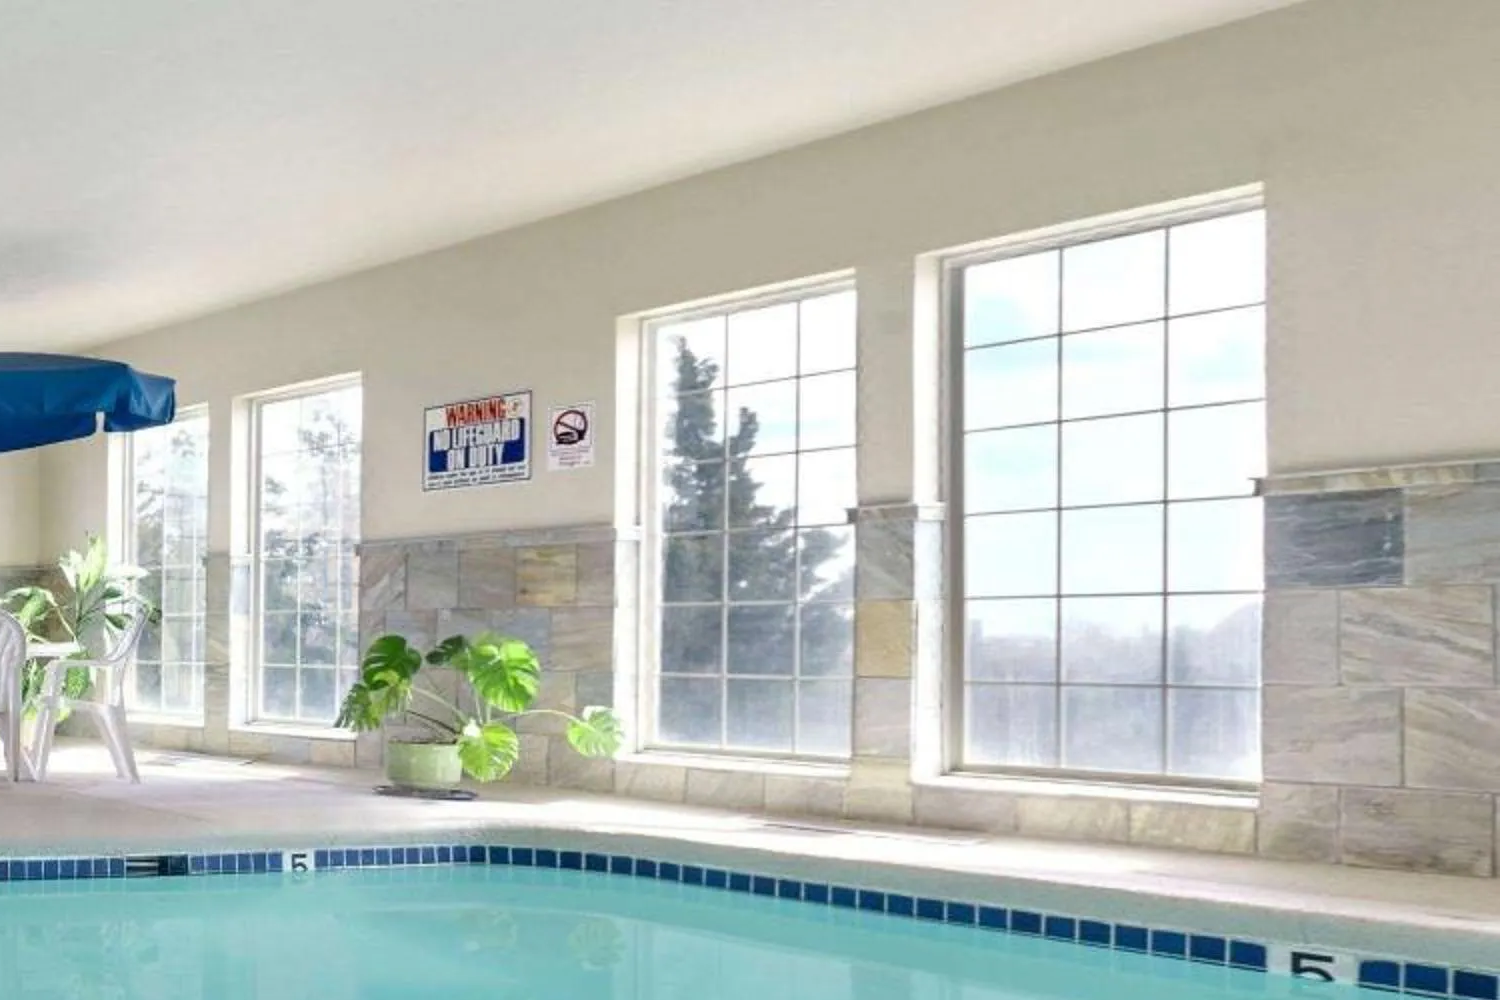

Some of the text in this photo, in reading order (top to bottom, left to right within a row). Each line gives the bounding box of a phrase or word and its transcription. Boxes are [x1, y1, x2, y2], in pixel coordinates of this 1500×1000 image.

[445, 396, 507, 427] WARNING
[433, 418, 521, 452] NO LIFEGUARD
[447, 442, 506, 471] ON DUTY
[291, 853, 308, 872] 5
[1291, 951, 1335, 982] 5
